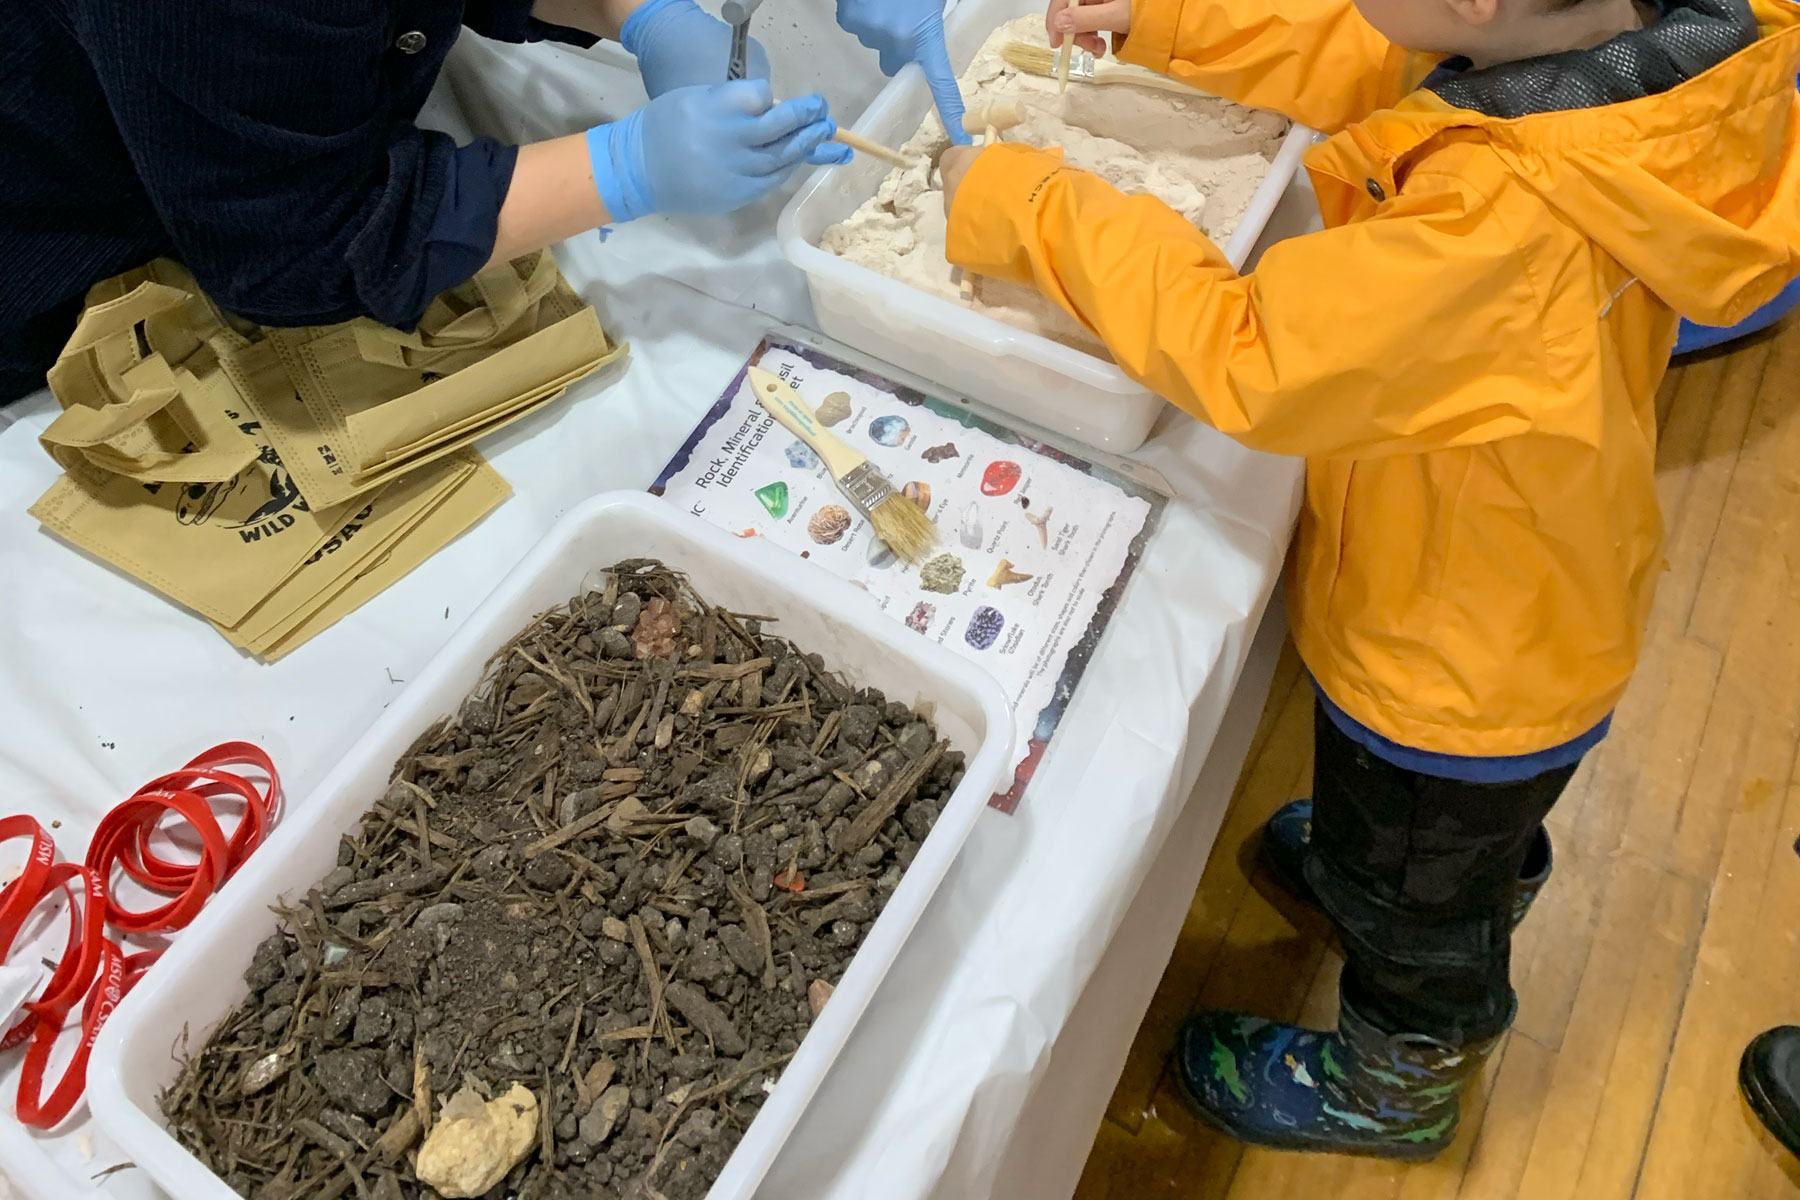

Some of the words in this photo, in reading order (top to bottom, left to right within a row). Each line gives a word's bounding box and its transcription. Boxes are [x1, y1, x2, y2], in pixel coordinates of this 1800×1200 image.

[695, 456, 730, 489] Rock,
[721, 409, 762, 456] Mineral
[787, 496, 809, 525] Aventurine
[940, 497, 951, 510] Eye
[238, 513, 296, 544] WILD
[841, 531, 855, 552] Desert
[852, 518, 866, 535] Rose
[986, 533, 1001, 555] Quartz
[996, 520, 1009, 537] Point
[1051, 536, 1063, 551] Sand
[1059, 521, 1070, 538] Tiger
[1058, 539, 1071, 557] Shark
[1067, 523, 1080, 542] Tooth
[962, 578, 977, 597] Pyrite
[1027, 576, 1043, 597] Otodus
[1032, 588, 1046, 607] Shark
[1042, 572, 1054, 590] Tooth
[940, 616, 956, 638] Stones
[999, 622, 1020, 655] Snowflake
[1008, 628, 1025, 655] Obsidian
[36, 833, 54, 867] MSU
[109, 953, 123, 989] MSU
[86, 1000, 115, 1048] CSAM
